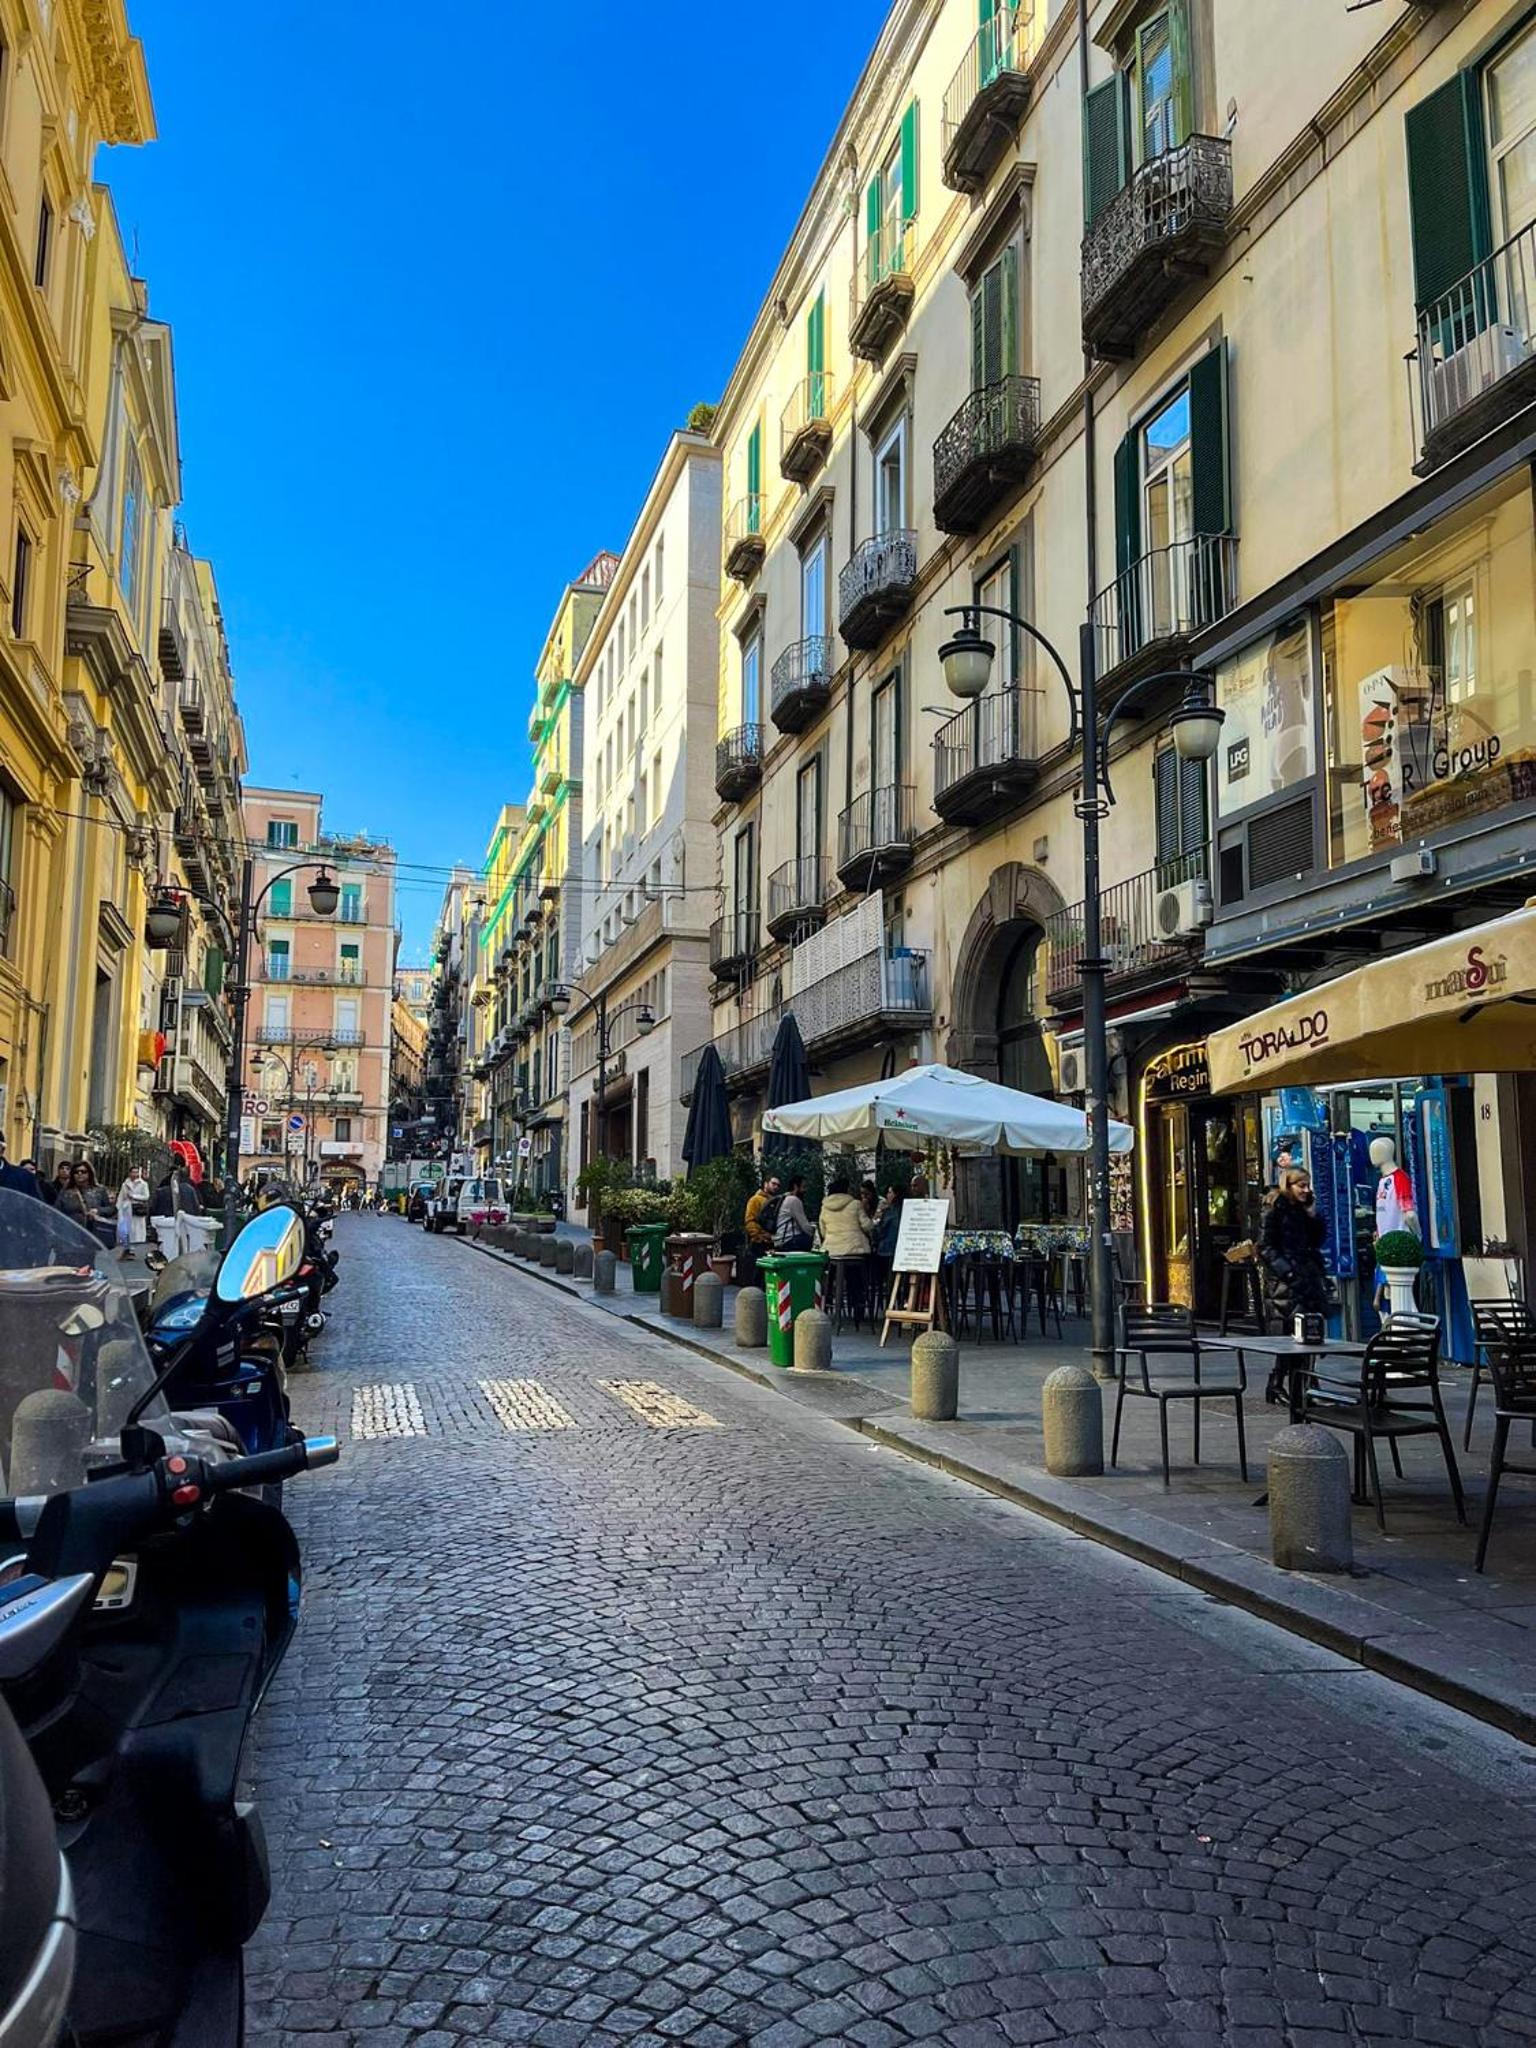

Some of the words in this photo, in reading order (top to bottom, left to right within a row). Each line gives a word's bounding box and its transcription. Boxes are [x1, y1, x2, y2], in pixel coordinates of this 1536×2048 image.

[1230, 747, 1248, 767] LPG
[1360, 779, 1392, 809] Tre
[1402, 763, 1414, 793] R
[1432, 735, 1500, 779] Group
[1239, 1010, 1328, 1065] TORALDO
[1146, 1047, 1208, 1090] Salum
[1170, 1069, 1210, 1091] Regin
[245, 1101, 269, 1115] RO
[1480, 1104, 1491, 1120] 18
